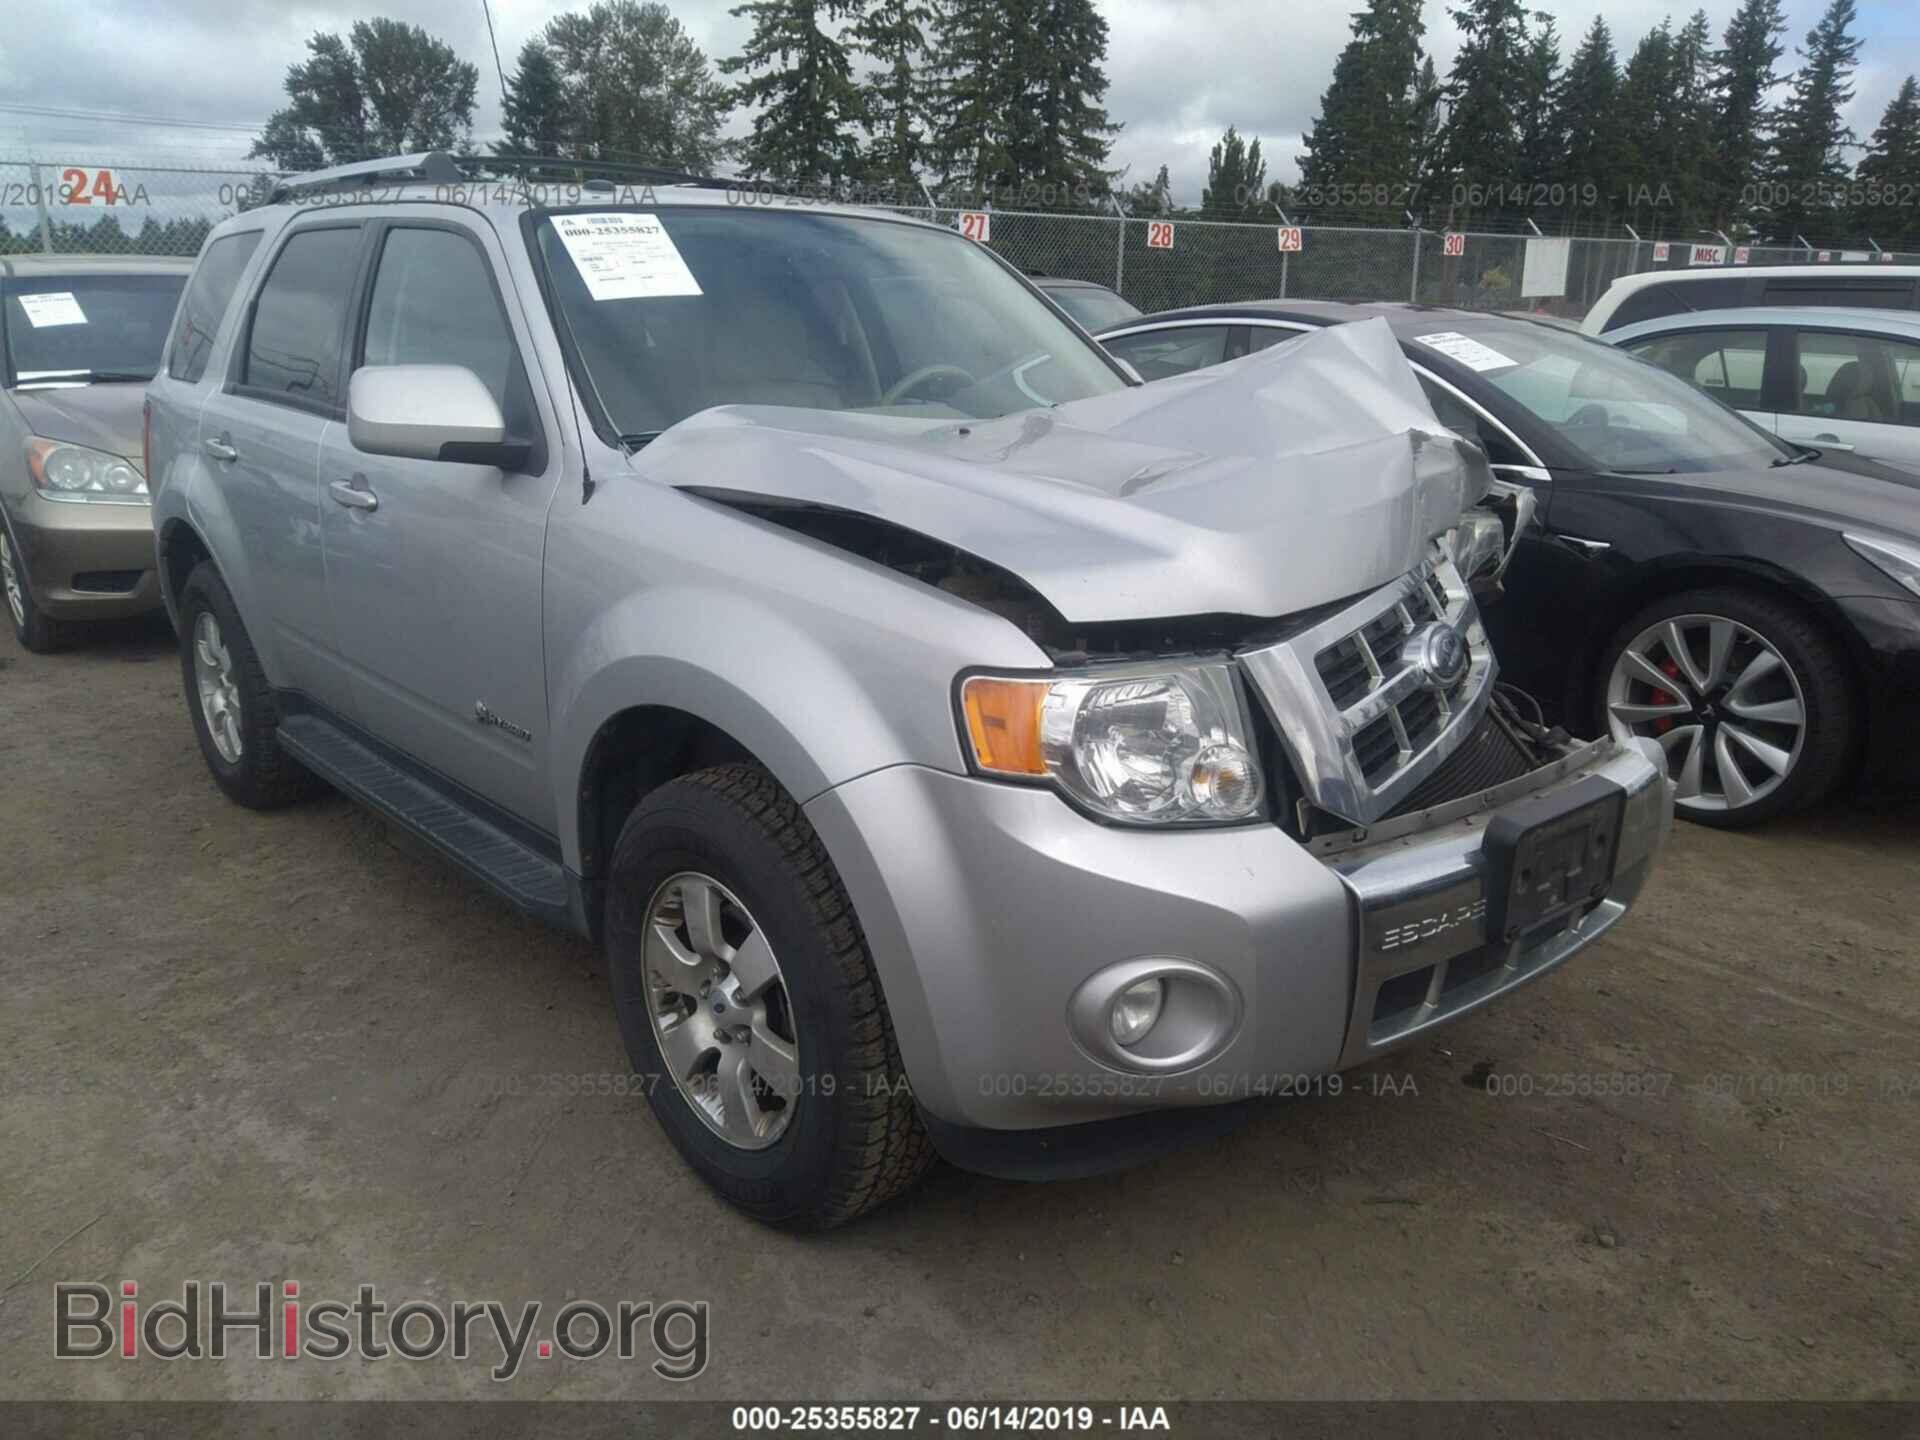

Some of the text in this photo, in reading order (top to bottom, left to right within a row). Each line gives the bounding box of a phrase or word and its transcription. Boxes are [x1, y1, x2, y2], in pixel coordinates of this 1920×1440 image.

[62, 168, 120, 206] 24
[963, 215, 986, 241] 27
[1150, 223, 1173, 248] 28
[1279, 229, 1302, 251] 29
[1445, 235, 1463, 255] 30
